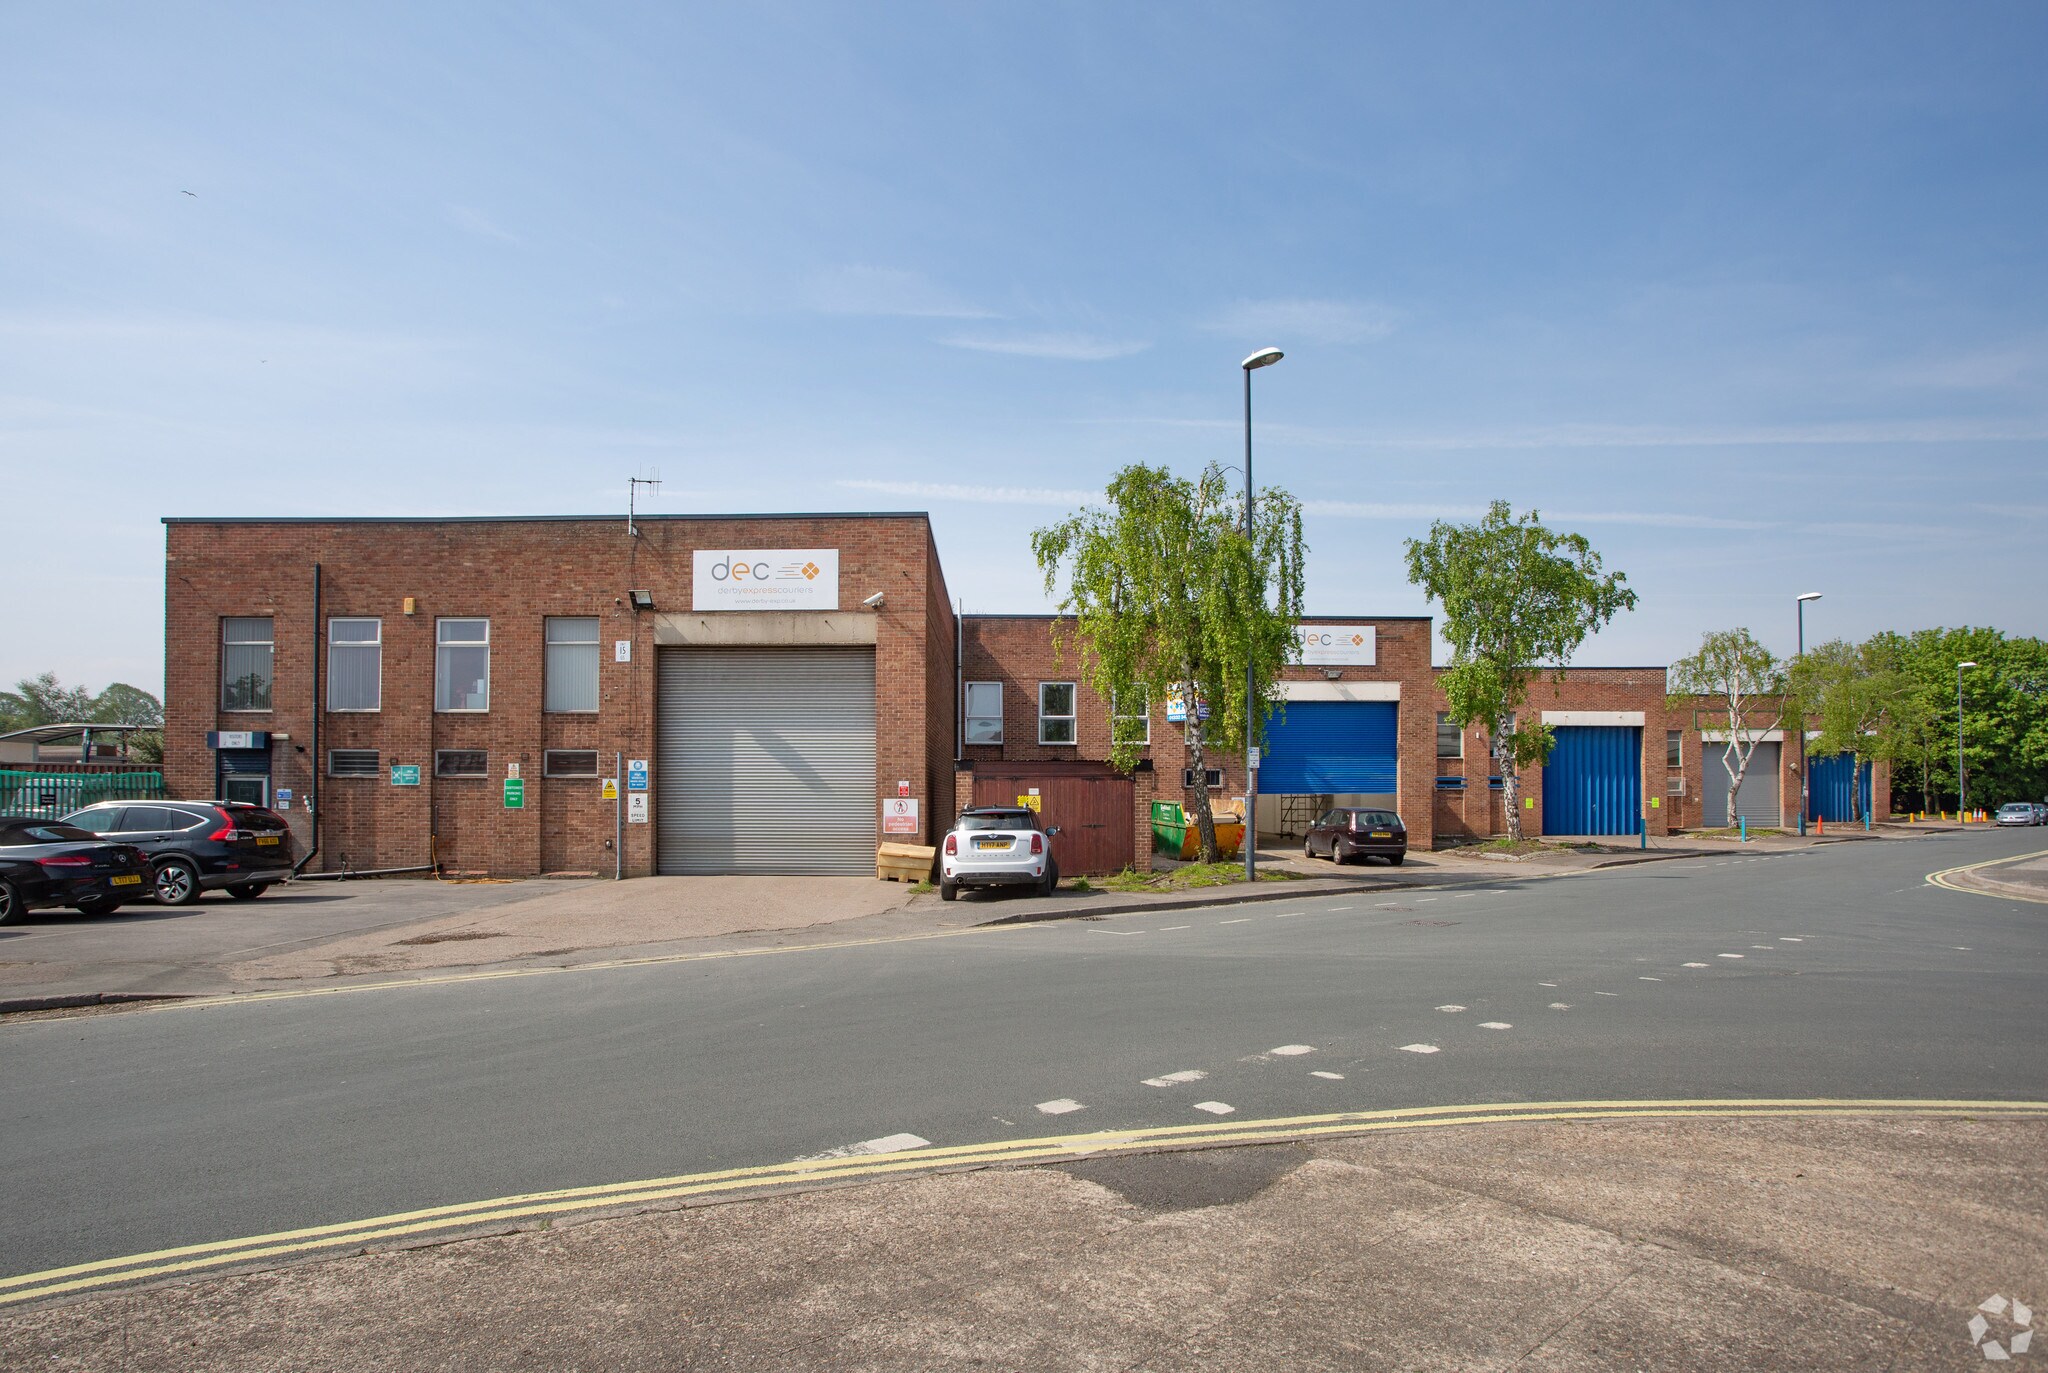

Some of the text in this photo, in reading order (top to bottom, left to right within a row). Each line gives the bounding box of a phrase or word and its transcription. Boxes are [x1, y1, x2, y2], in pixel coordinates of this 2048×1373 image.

[711, 555, 770, 581] dec
[717, 586, 814, 596] derbyexpresscouriers
[1297, 629, 1332, 646] dec
[635, 797, 641, 805] 5
